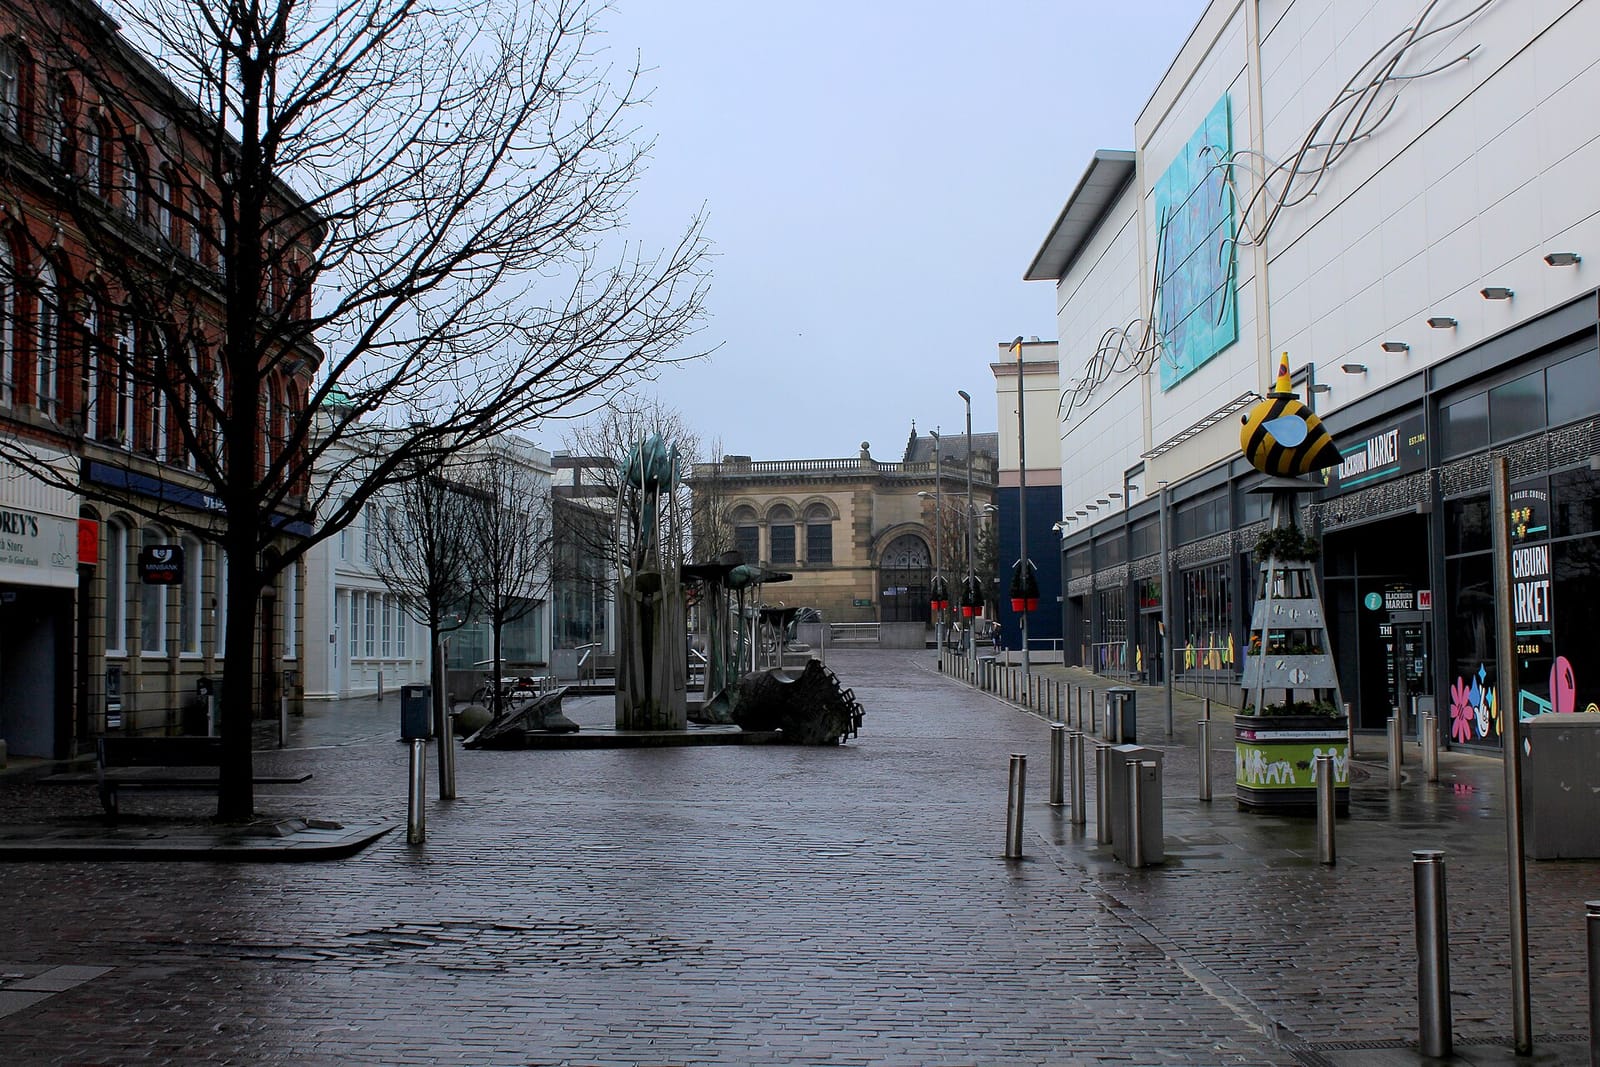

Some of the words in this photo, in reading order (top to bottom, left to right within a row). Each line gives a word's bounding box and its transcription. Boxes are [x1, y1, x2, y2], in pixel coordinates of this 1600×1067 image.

[1408, 433, 1425, 446] EST.184
[1367, 428, 1399, 471] MARKET
[0, 511, 38, 537] REY'S
[7, 538, 23, 553] Store
[1512, 545, 1548, 578] CKBURN
[1385, 599, 1414, 609] MARKET
[1516, 645, 1539, 654] ST.1848
